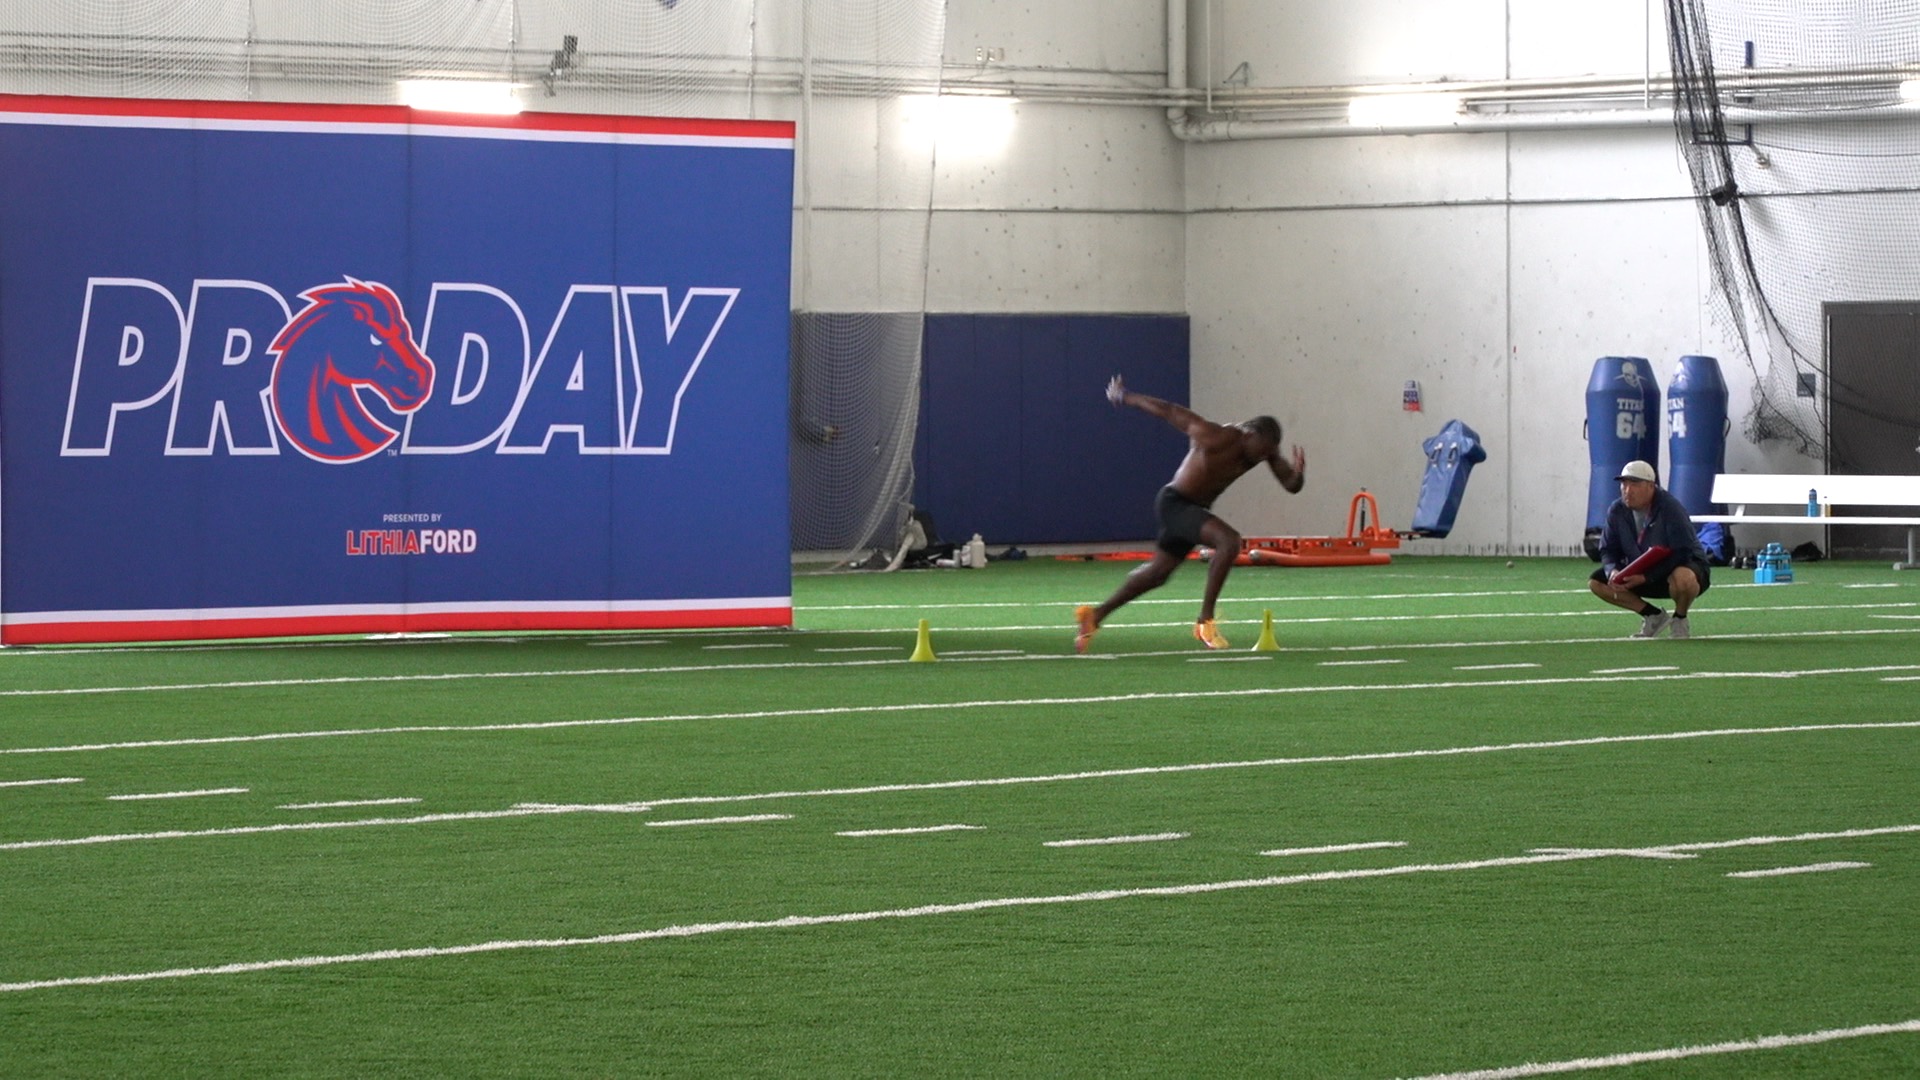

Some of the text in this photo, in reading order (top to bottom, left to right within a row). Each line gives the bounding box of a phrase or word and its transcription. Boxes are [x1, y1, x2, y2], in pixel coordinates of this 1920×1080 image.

[401, 282, 741, 455] DAY
[1616, 411, 1647, 439] 64
[383, 513, 442, 522] PRESENTED BY
